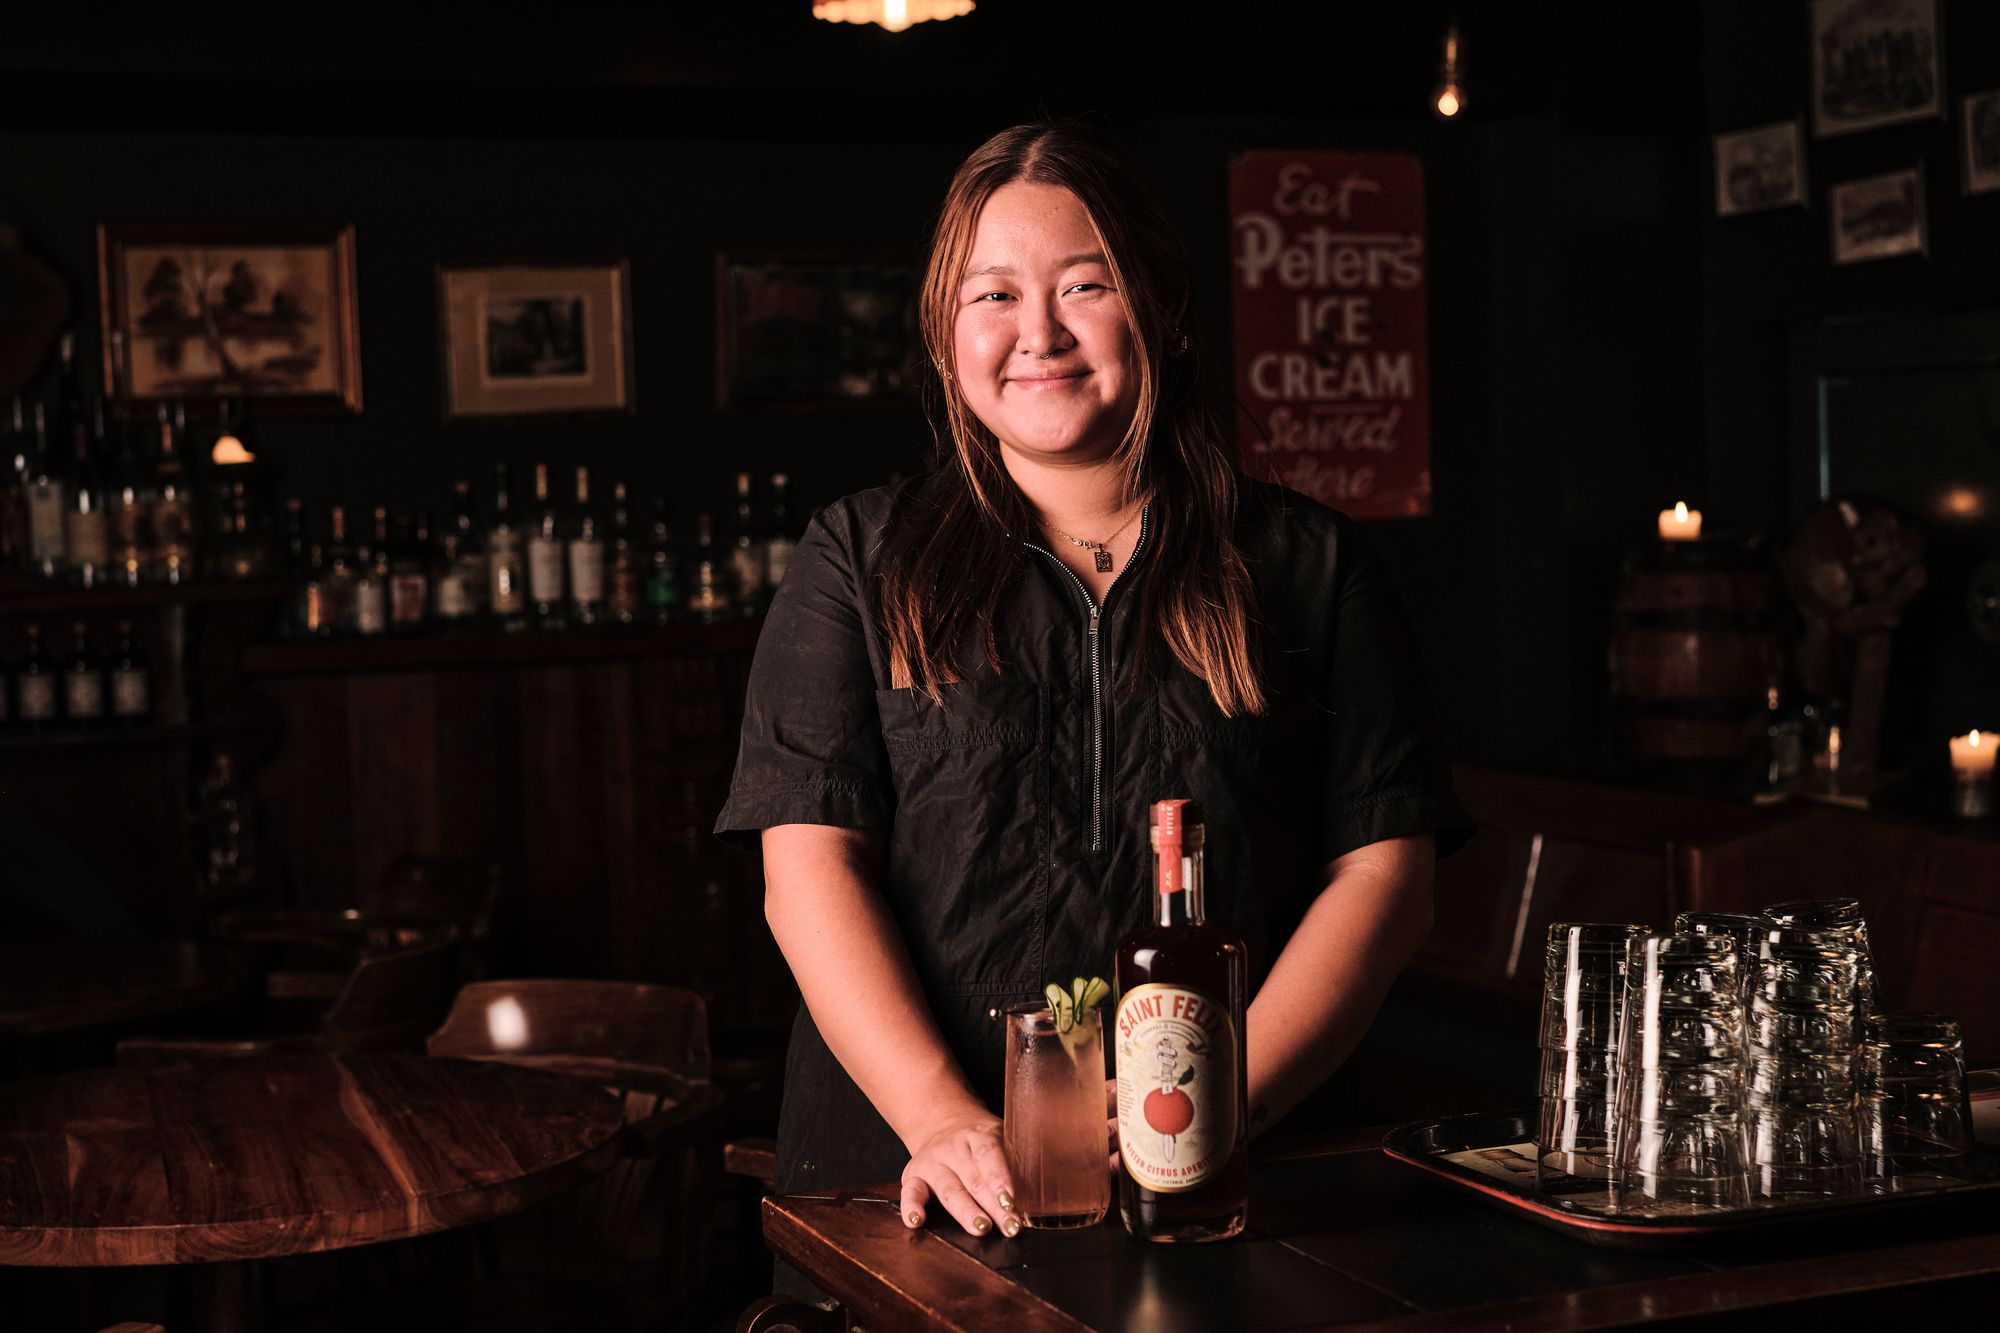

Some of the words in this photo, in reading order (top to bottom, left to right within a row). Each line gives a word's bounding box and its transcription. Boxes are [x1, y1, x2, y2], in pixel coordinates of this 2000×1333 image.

[1274, 162, 1382, 221] Eat
[1234, 212, 1423, 289] Peters
[1296, 294, 1373, 346] ICE
[1249, 350, 1414, 402] CREAM
[1254, 403, 1404, 453] Served
[1119, 994, 1163, 1039] SAINT
[1146, 1164, 1179, 1177] CITRUS
